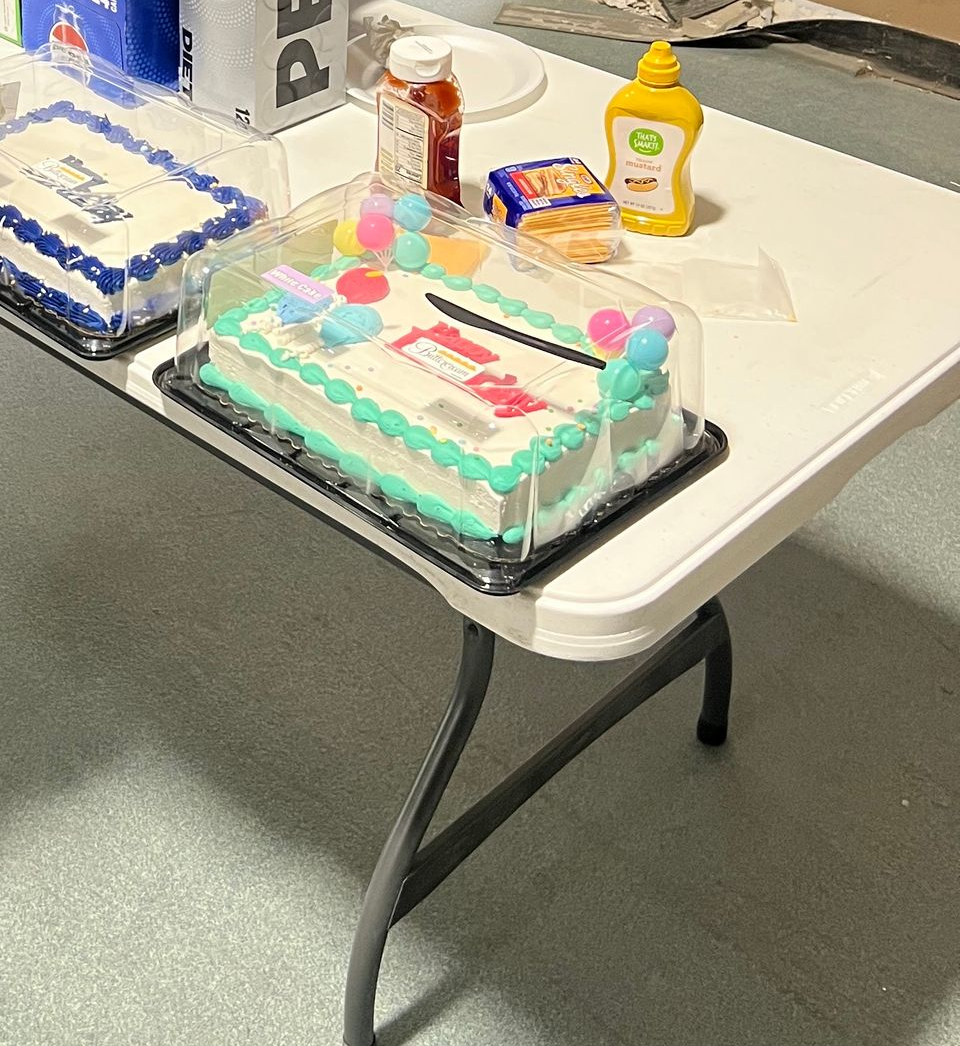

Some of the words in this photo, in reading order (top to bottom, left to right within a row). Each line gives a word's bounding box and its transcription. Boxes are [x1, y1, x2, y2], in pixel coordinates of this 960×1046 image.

[182, 26, 193, 102] DIET
[235, 107, 250, 125] 12
[625, 160, 662, 172] mustard
[268, 268, 299, 287] White
[297, 283, 322, 300] Cake
[407, 341, 470, 378] Buttercream
